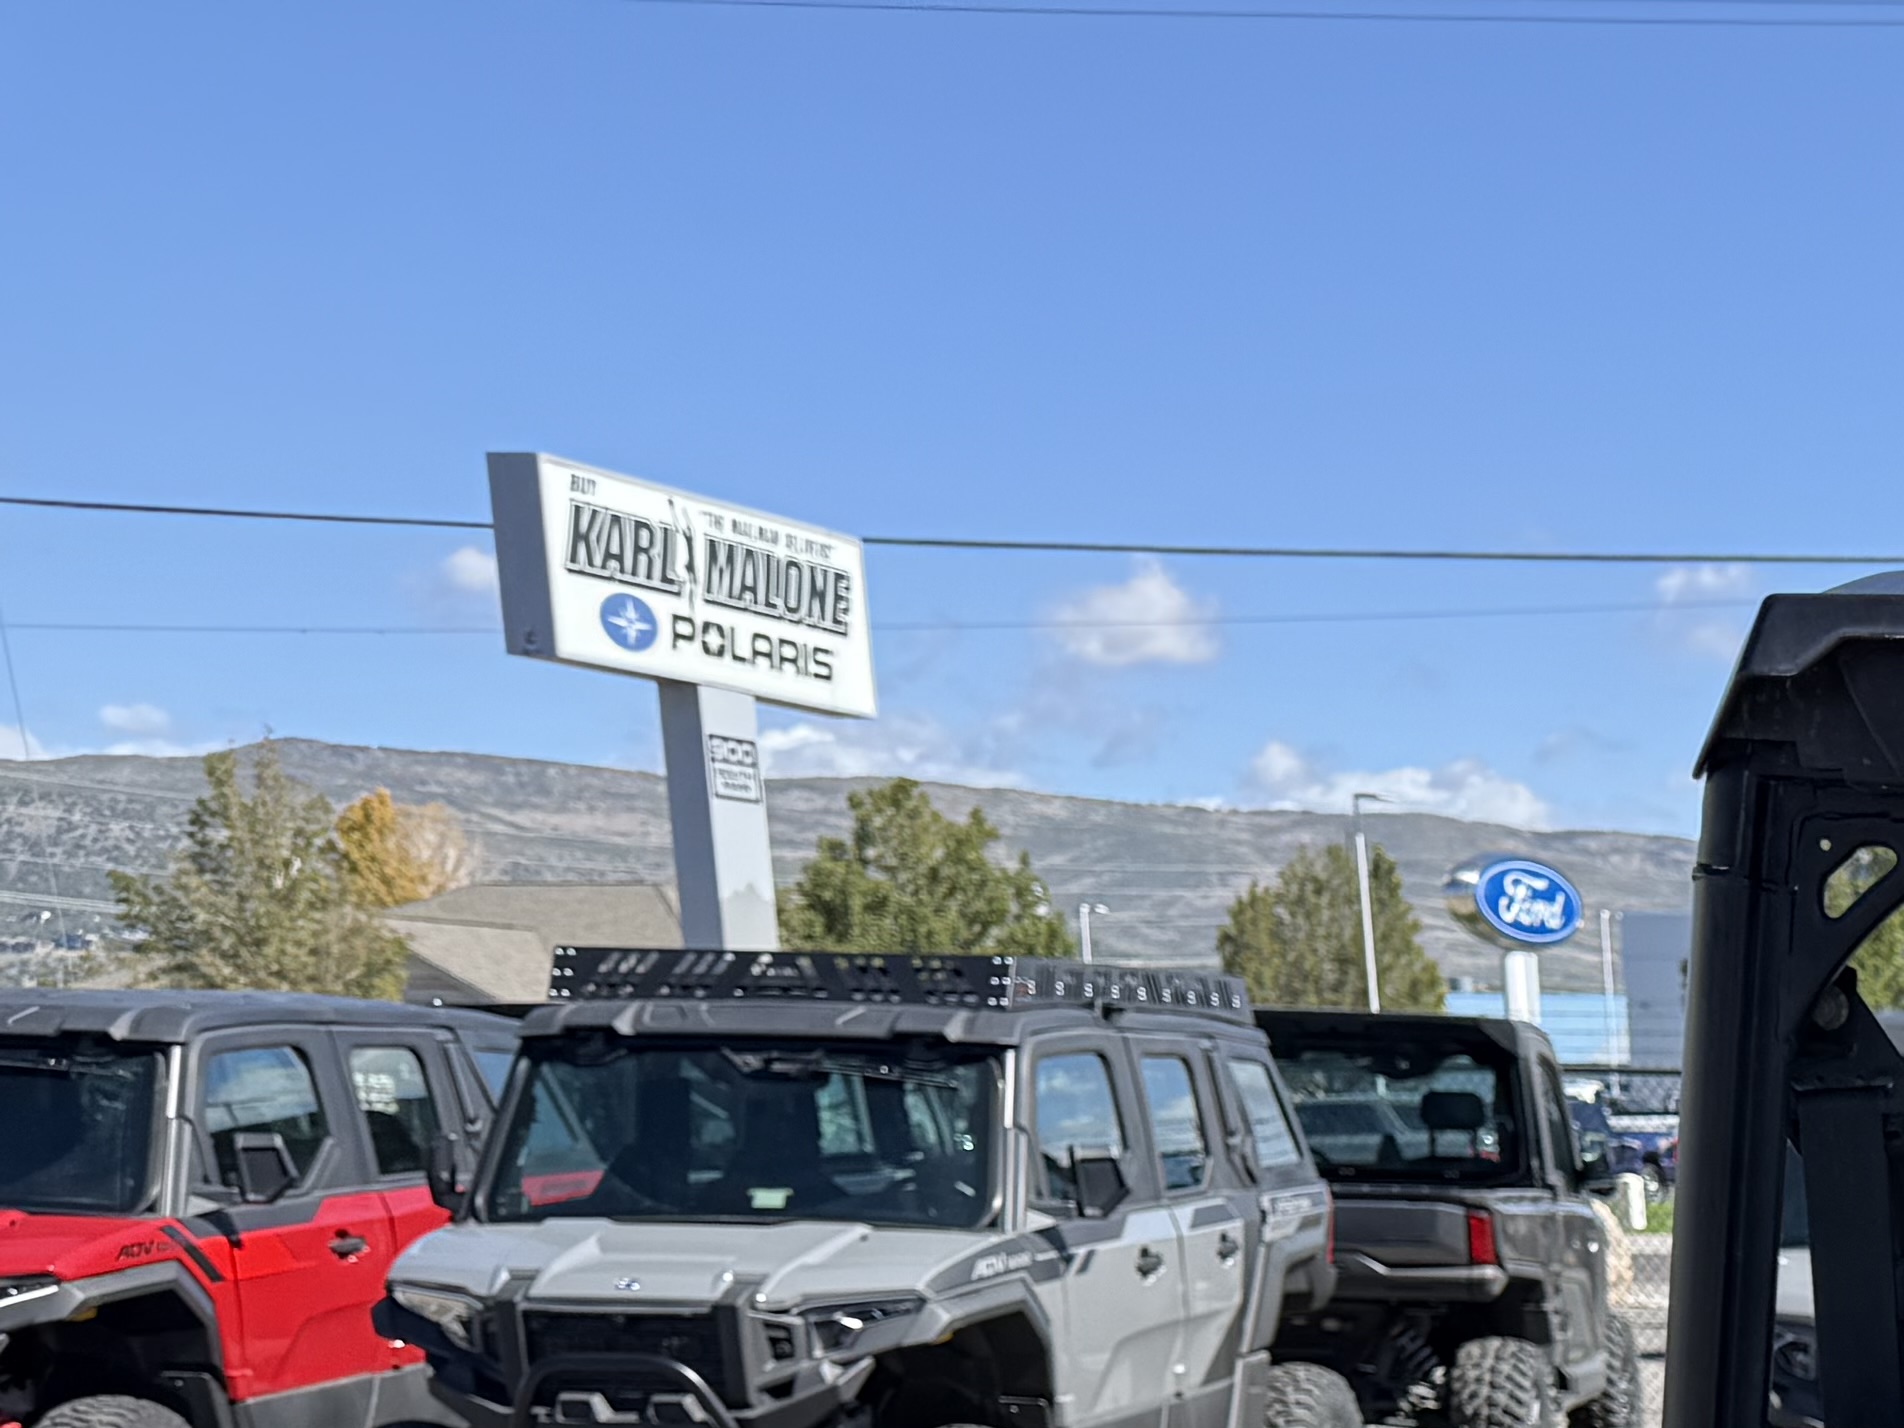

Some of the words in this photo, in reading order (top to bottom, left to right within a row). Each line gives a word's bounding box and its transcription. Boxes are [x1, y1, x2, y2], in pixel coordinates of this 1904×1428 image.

[565, 499, 683, 596] KARL
[702, 533, 850, 636] MALONE
[671, 613, 837, 681] POLARIS
[1498, 871, 1567, 931] Ford
